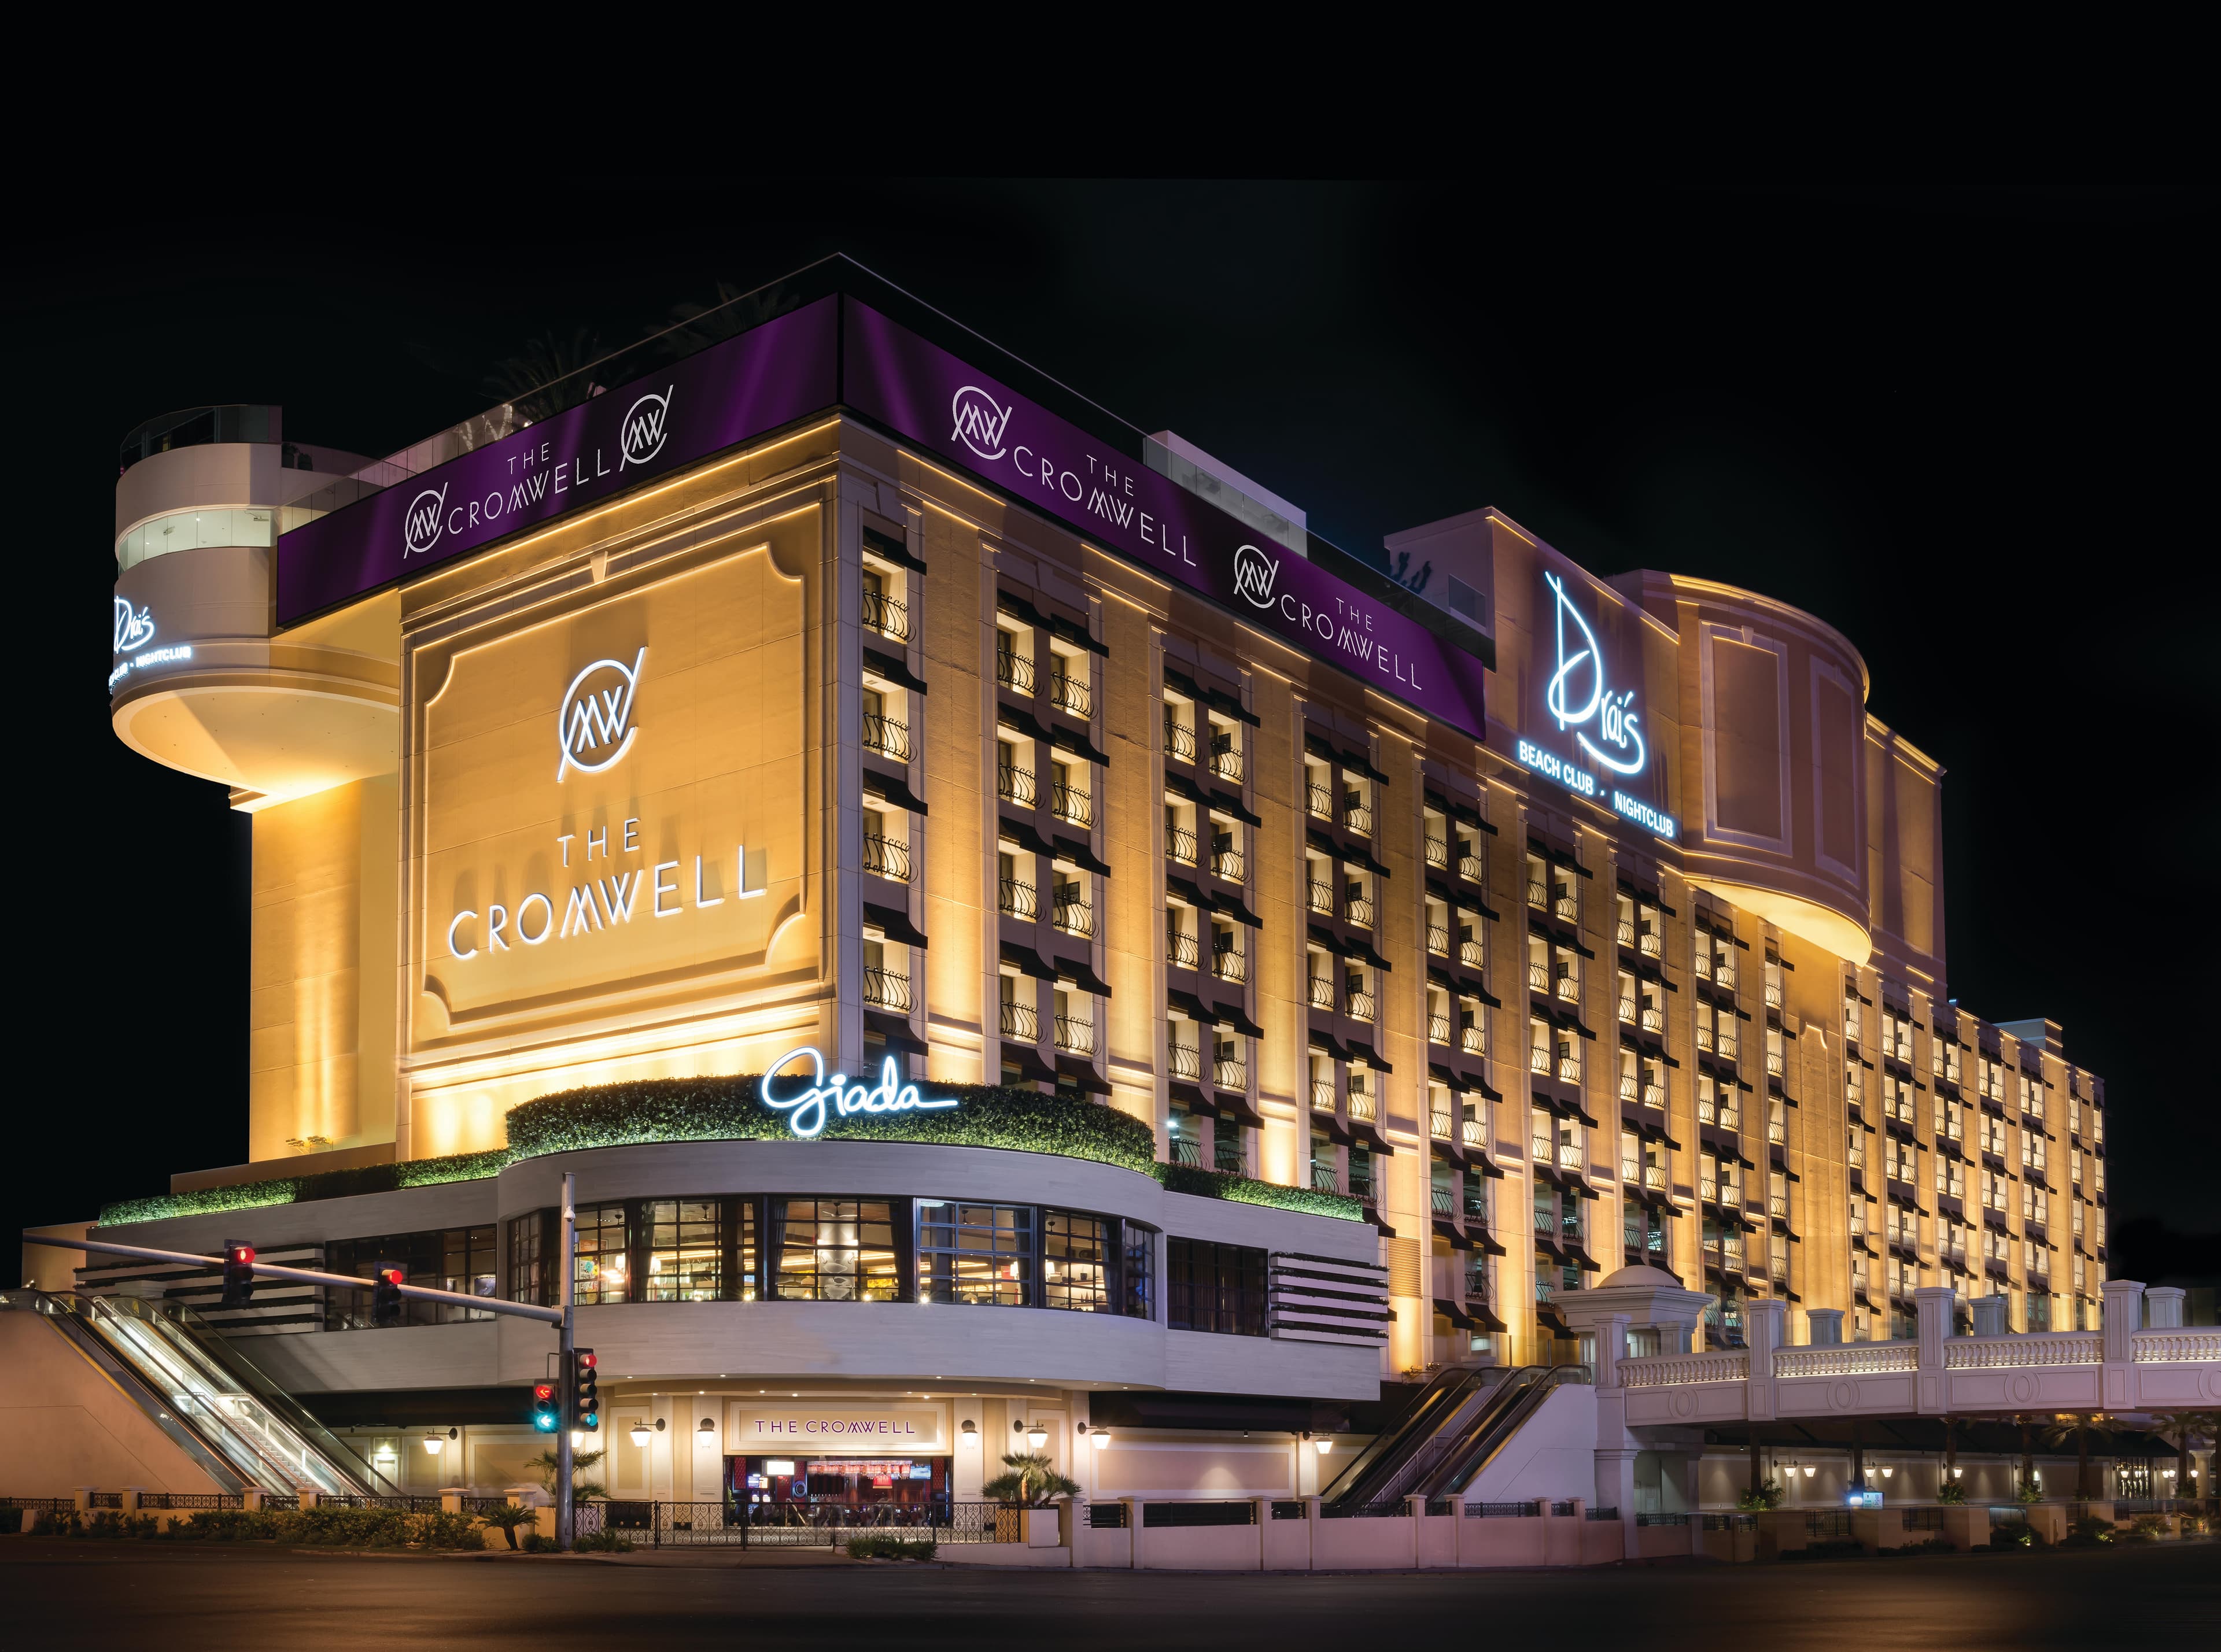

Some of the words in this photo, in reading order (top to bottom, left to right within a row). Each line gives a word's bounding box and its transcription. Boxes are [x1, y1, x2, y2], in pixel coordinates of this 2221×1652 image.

[448, 448, 610, 535] CROMWELL
[507, 442, 549, 475] THE
[1086, 454, 1134, 496] THE
[1013, 445, 1197, 567] CROMWELL
[1281, 594, 1422, 690] CROMWELL
[1335, 597, 1373, 631] THE
[135, 646, 191, 667] NIGHTCLUB
[1519, 741, 1560, 779] BEACH
[1563, 764, 1594, 796] CLUB
[1614, 790, 1674, 837] NIGHTCLUB
[556, 817, 640, 867] THE
[448, 844, 768, 959] CROMWELL
[762, 1047, 958, 1137] Giada
[755, 1420, 798, 1433] THE
[806, 1420, 916, 1434] CROMWELL
